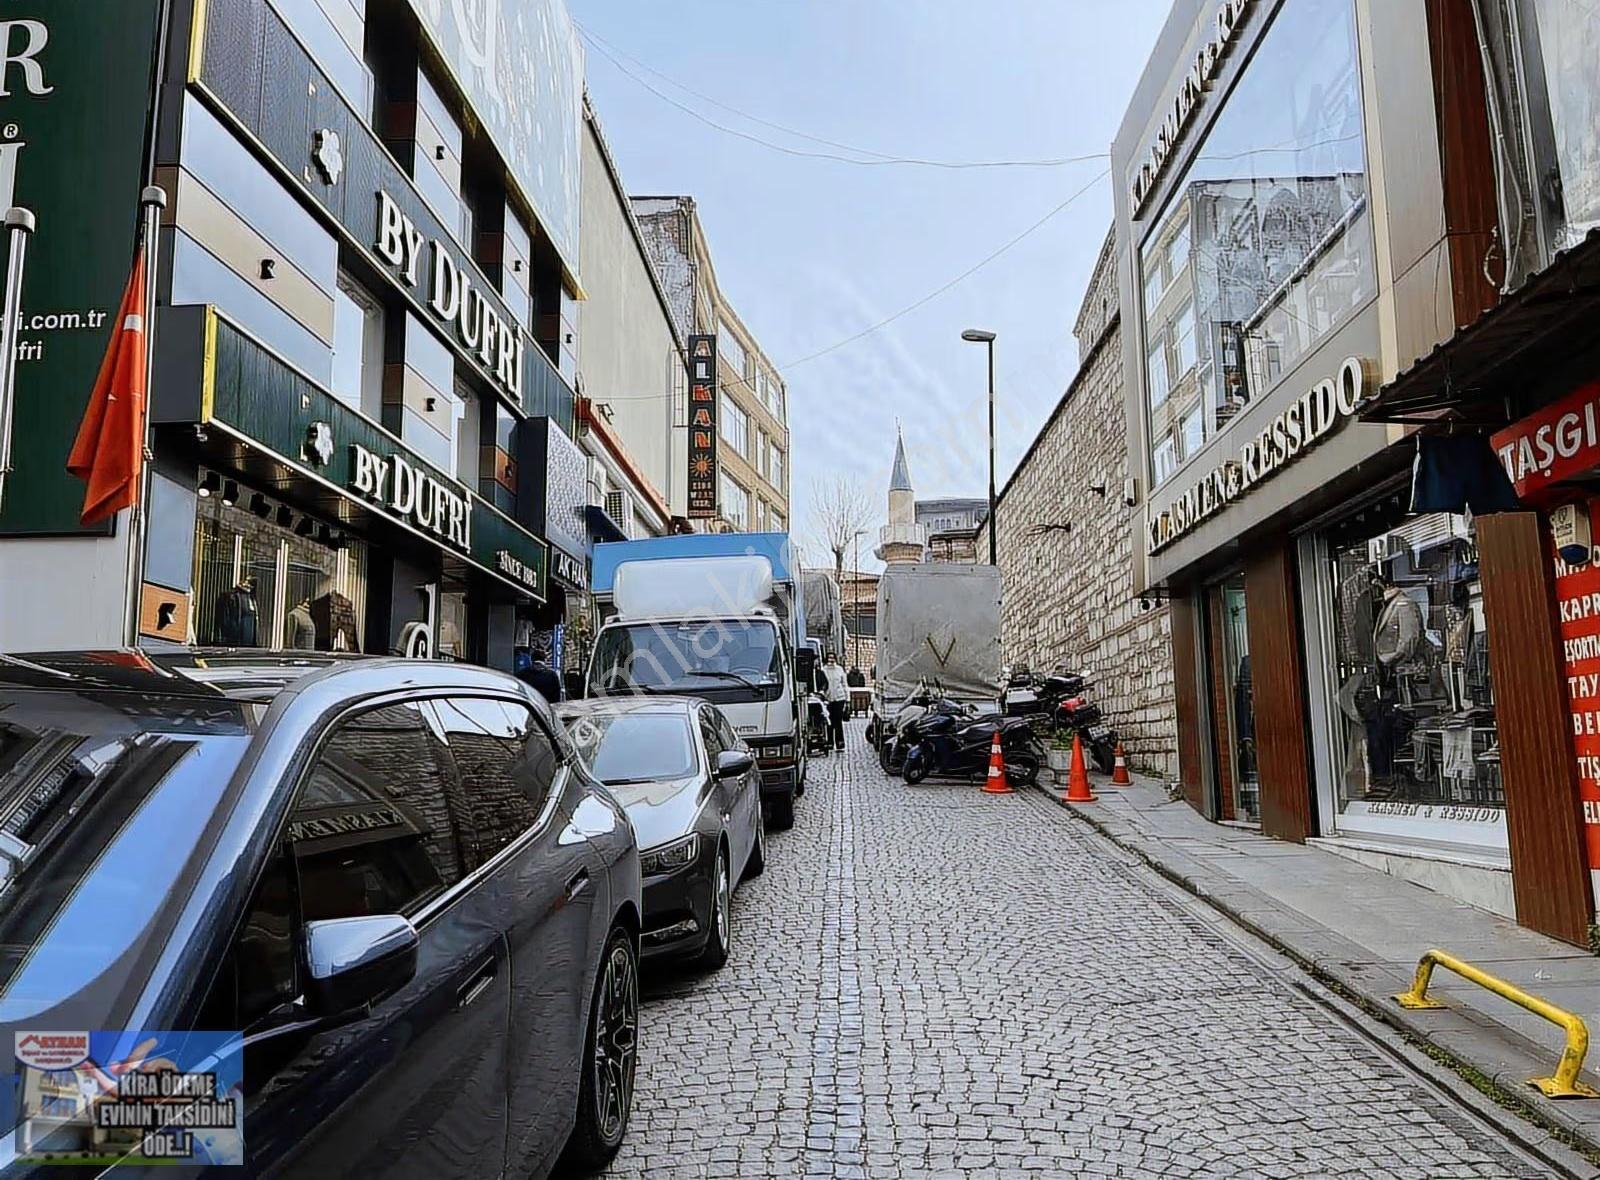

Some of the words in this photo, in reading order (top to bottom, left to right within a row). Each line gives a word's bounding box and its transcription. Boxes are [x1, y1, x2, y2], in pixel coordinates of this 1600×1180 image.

[377, 189, 424, 287] BY
[430, 237, 525, 407] DUFRİ
[692, 340, 713, 449] ALKAN
[1240, 356, 1364, 491] RESSIDO
[354, 444, 390, 501] BY
[389, 453, 473, 555] DUFRİ
